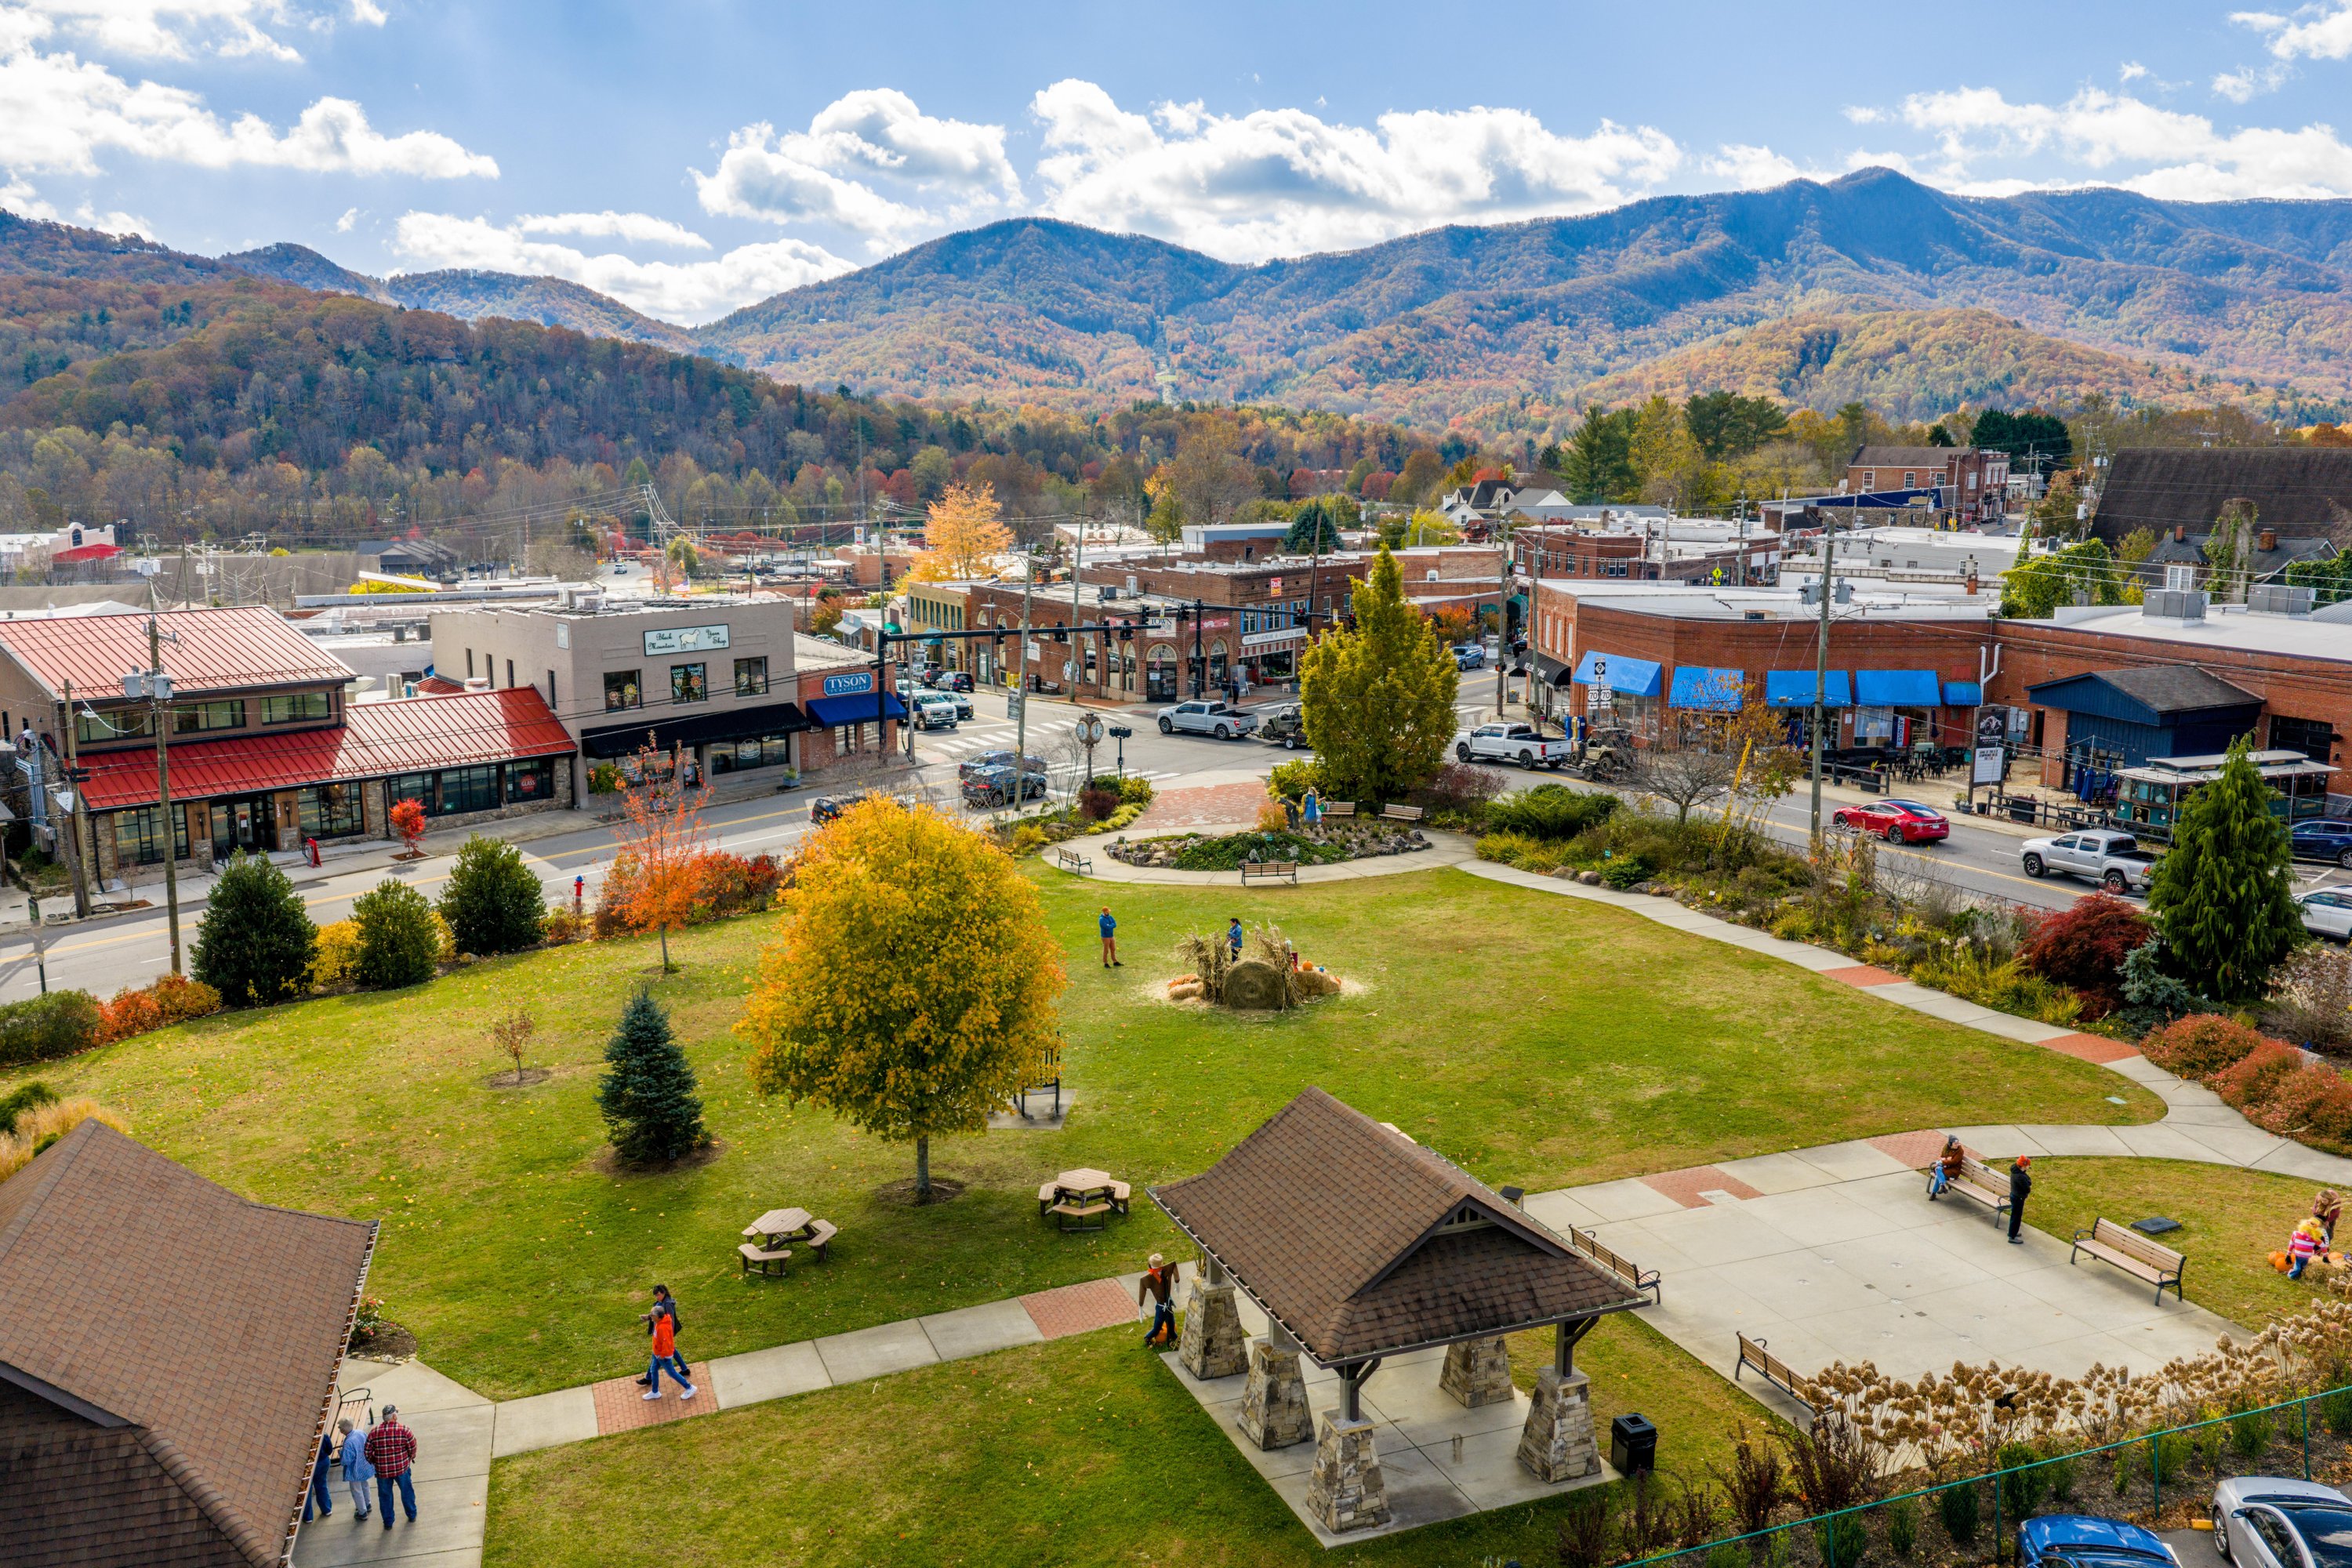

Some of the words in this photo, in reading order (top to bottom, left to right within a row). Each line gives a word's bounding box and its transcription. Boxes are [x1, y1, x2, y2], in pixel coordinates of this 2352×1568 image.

[706, 629, 720, 639] Yarn
[712, 637, 727, 646] Shop
[829, 676, 867, 688] TYSON
